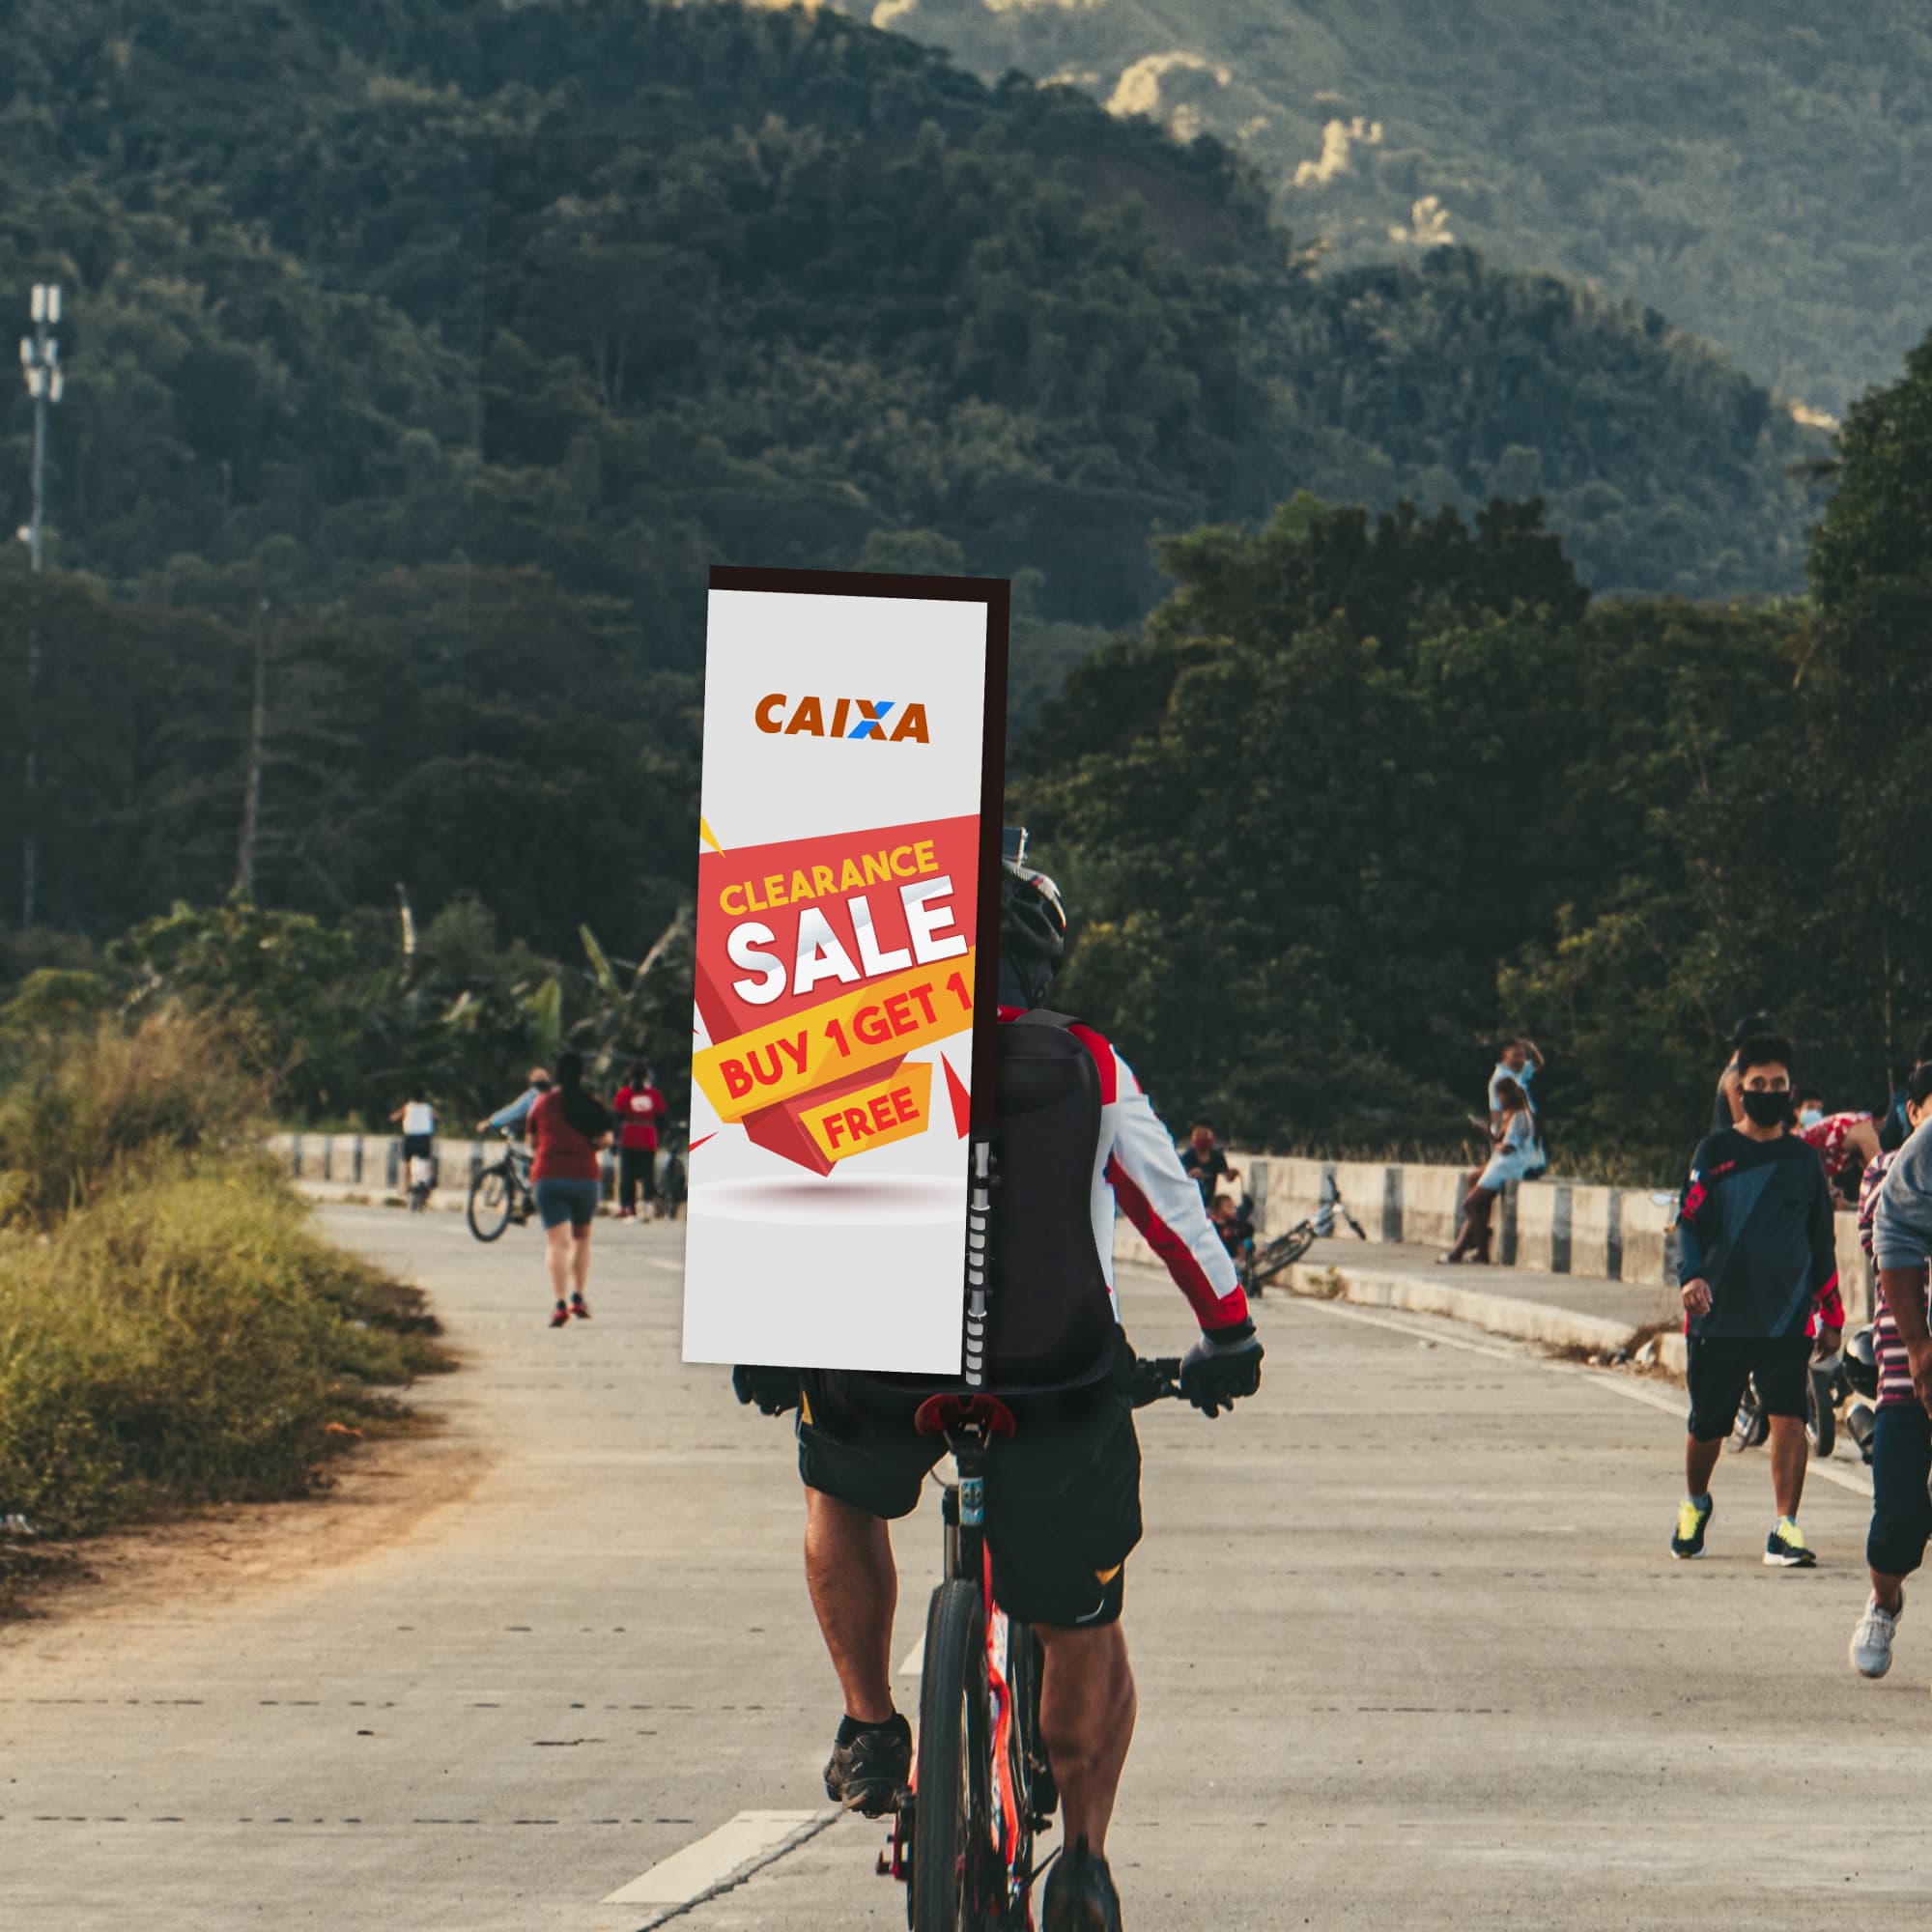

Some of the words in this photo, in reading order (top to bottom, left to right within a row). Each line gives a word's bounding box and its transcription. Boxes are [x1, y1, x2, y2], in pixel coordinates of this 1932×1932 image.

[754, 694, 929, 743] CAIXA
[719, 839, 939, 916] CLEARANCE
[726, 874, 969, 1005] SALE
[719, 1031, 808, 1099] BUY
[824, 1019, 851, 1058] 1
[852, 982, 937, 1045] GET
[946, 971, 973, 1011] 1
[822, 1086, 920, 1150] FREE
